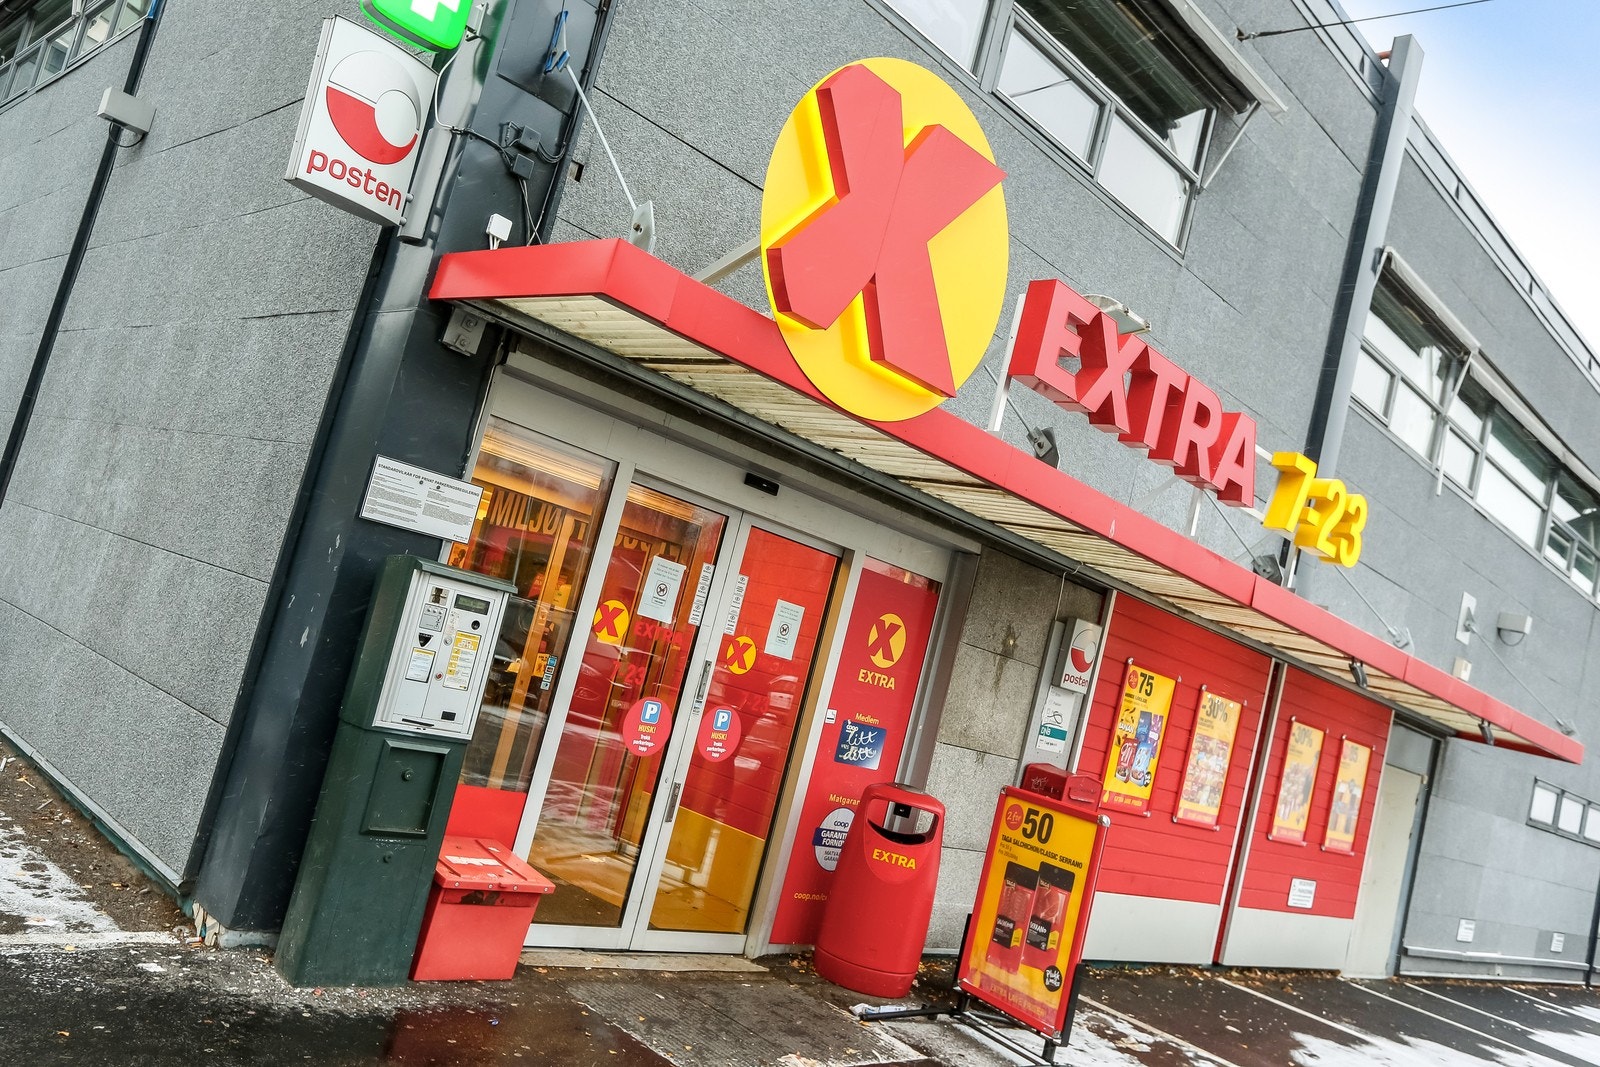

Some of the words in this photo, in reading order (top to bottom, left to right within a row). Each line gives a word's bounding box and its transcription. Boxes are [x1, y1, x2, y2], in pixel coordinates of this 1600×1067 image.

[306, 149, 402, 211] posten
[1008, 279, 1257, 508] EXTRA
[1263, 452, 1368, 568] 7-23
[858, 668, 895, 690] EXTRA
[1063, 673, 1089, 688] posten
[1138, 671, 1155, 697] 75
[638, 724, 656, 734] HUSK!
[855, 713, 880, 725] Medlem
[834, 821, 849, 829] coop
[1022, 807, 1054, 845] 50
[872, 848, 916, 870] EXTRA
[1001, 834, 1013, 843] TAGA
[1058, 856, 1083, 870] SERRANO
